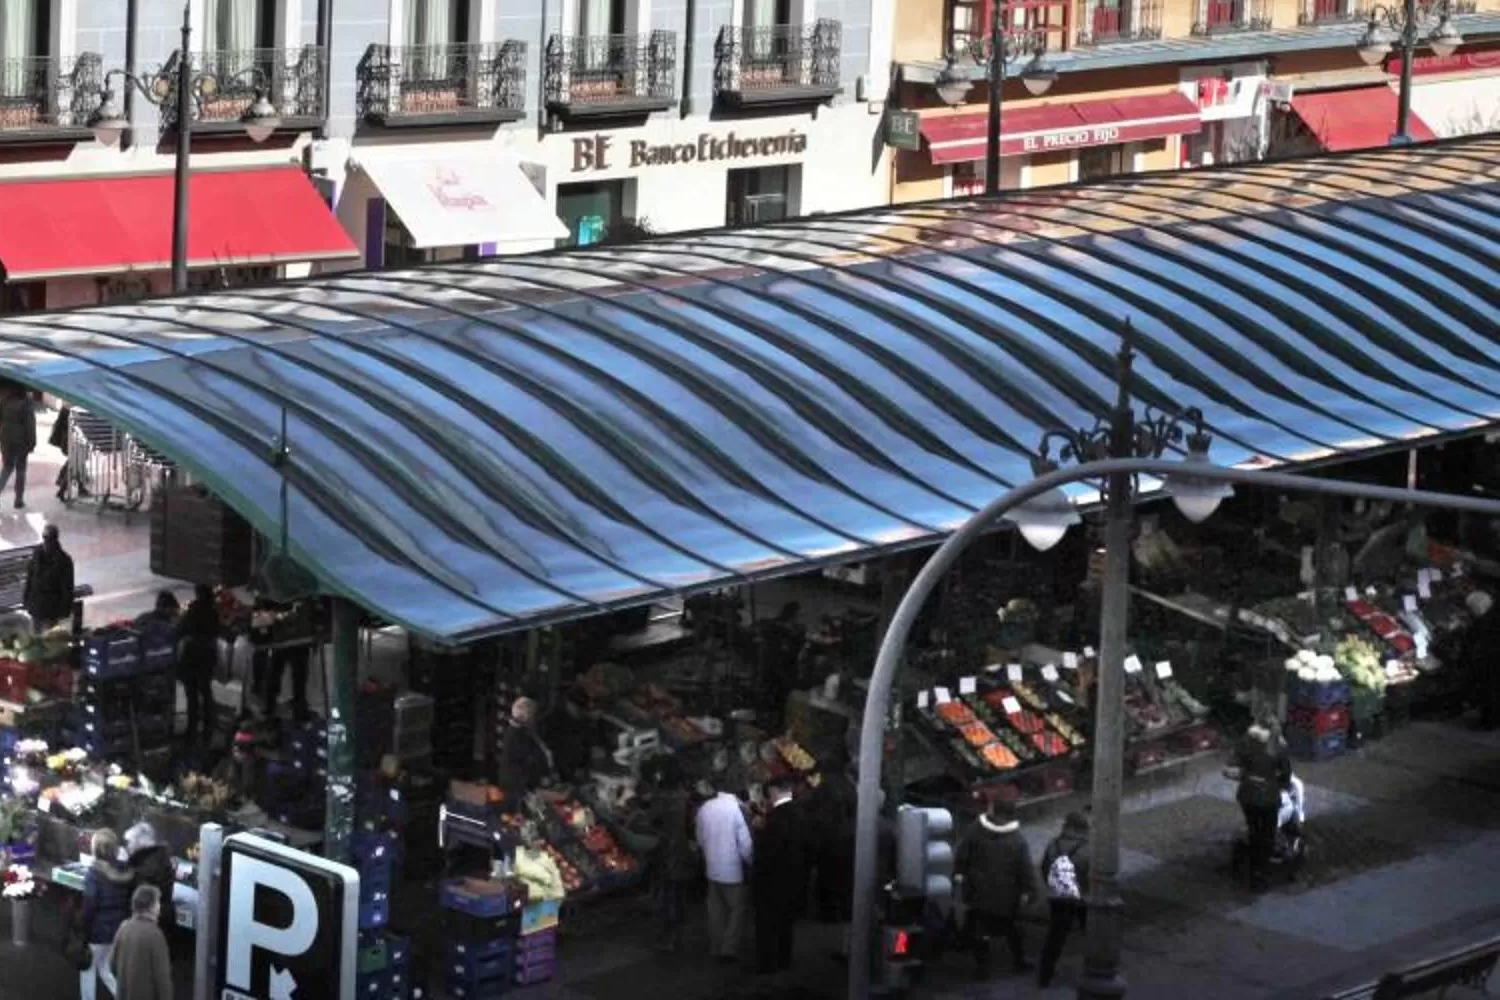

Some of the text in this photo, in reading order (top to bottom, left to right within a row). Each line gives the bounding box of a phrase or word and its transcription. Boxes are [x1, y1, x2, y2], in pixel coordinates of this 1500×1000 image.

[571, 133, 612, 172] BE
[1023, 136, 1039, 151] EL
[1043, 130, 1089, 148] PRECIO
[226, 851, 319, 992] P
